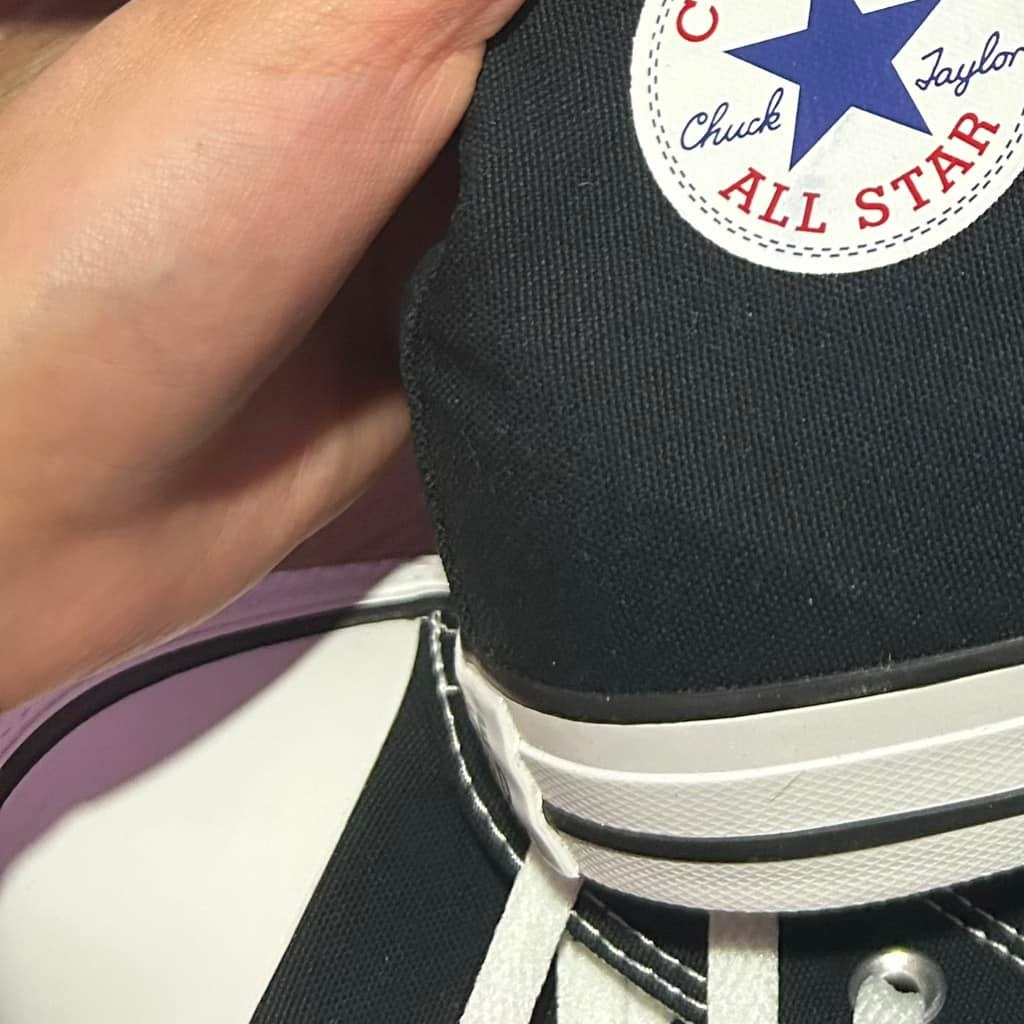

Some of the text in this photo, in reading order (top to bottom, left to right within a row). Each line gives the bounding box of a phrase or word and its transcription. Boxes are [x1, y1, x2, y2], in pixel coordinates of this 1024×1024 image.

[680, 87, 784, 151] Chuck
[718, 112, 1000, 234] ALL STAR
